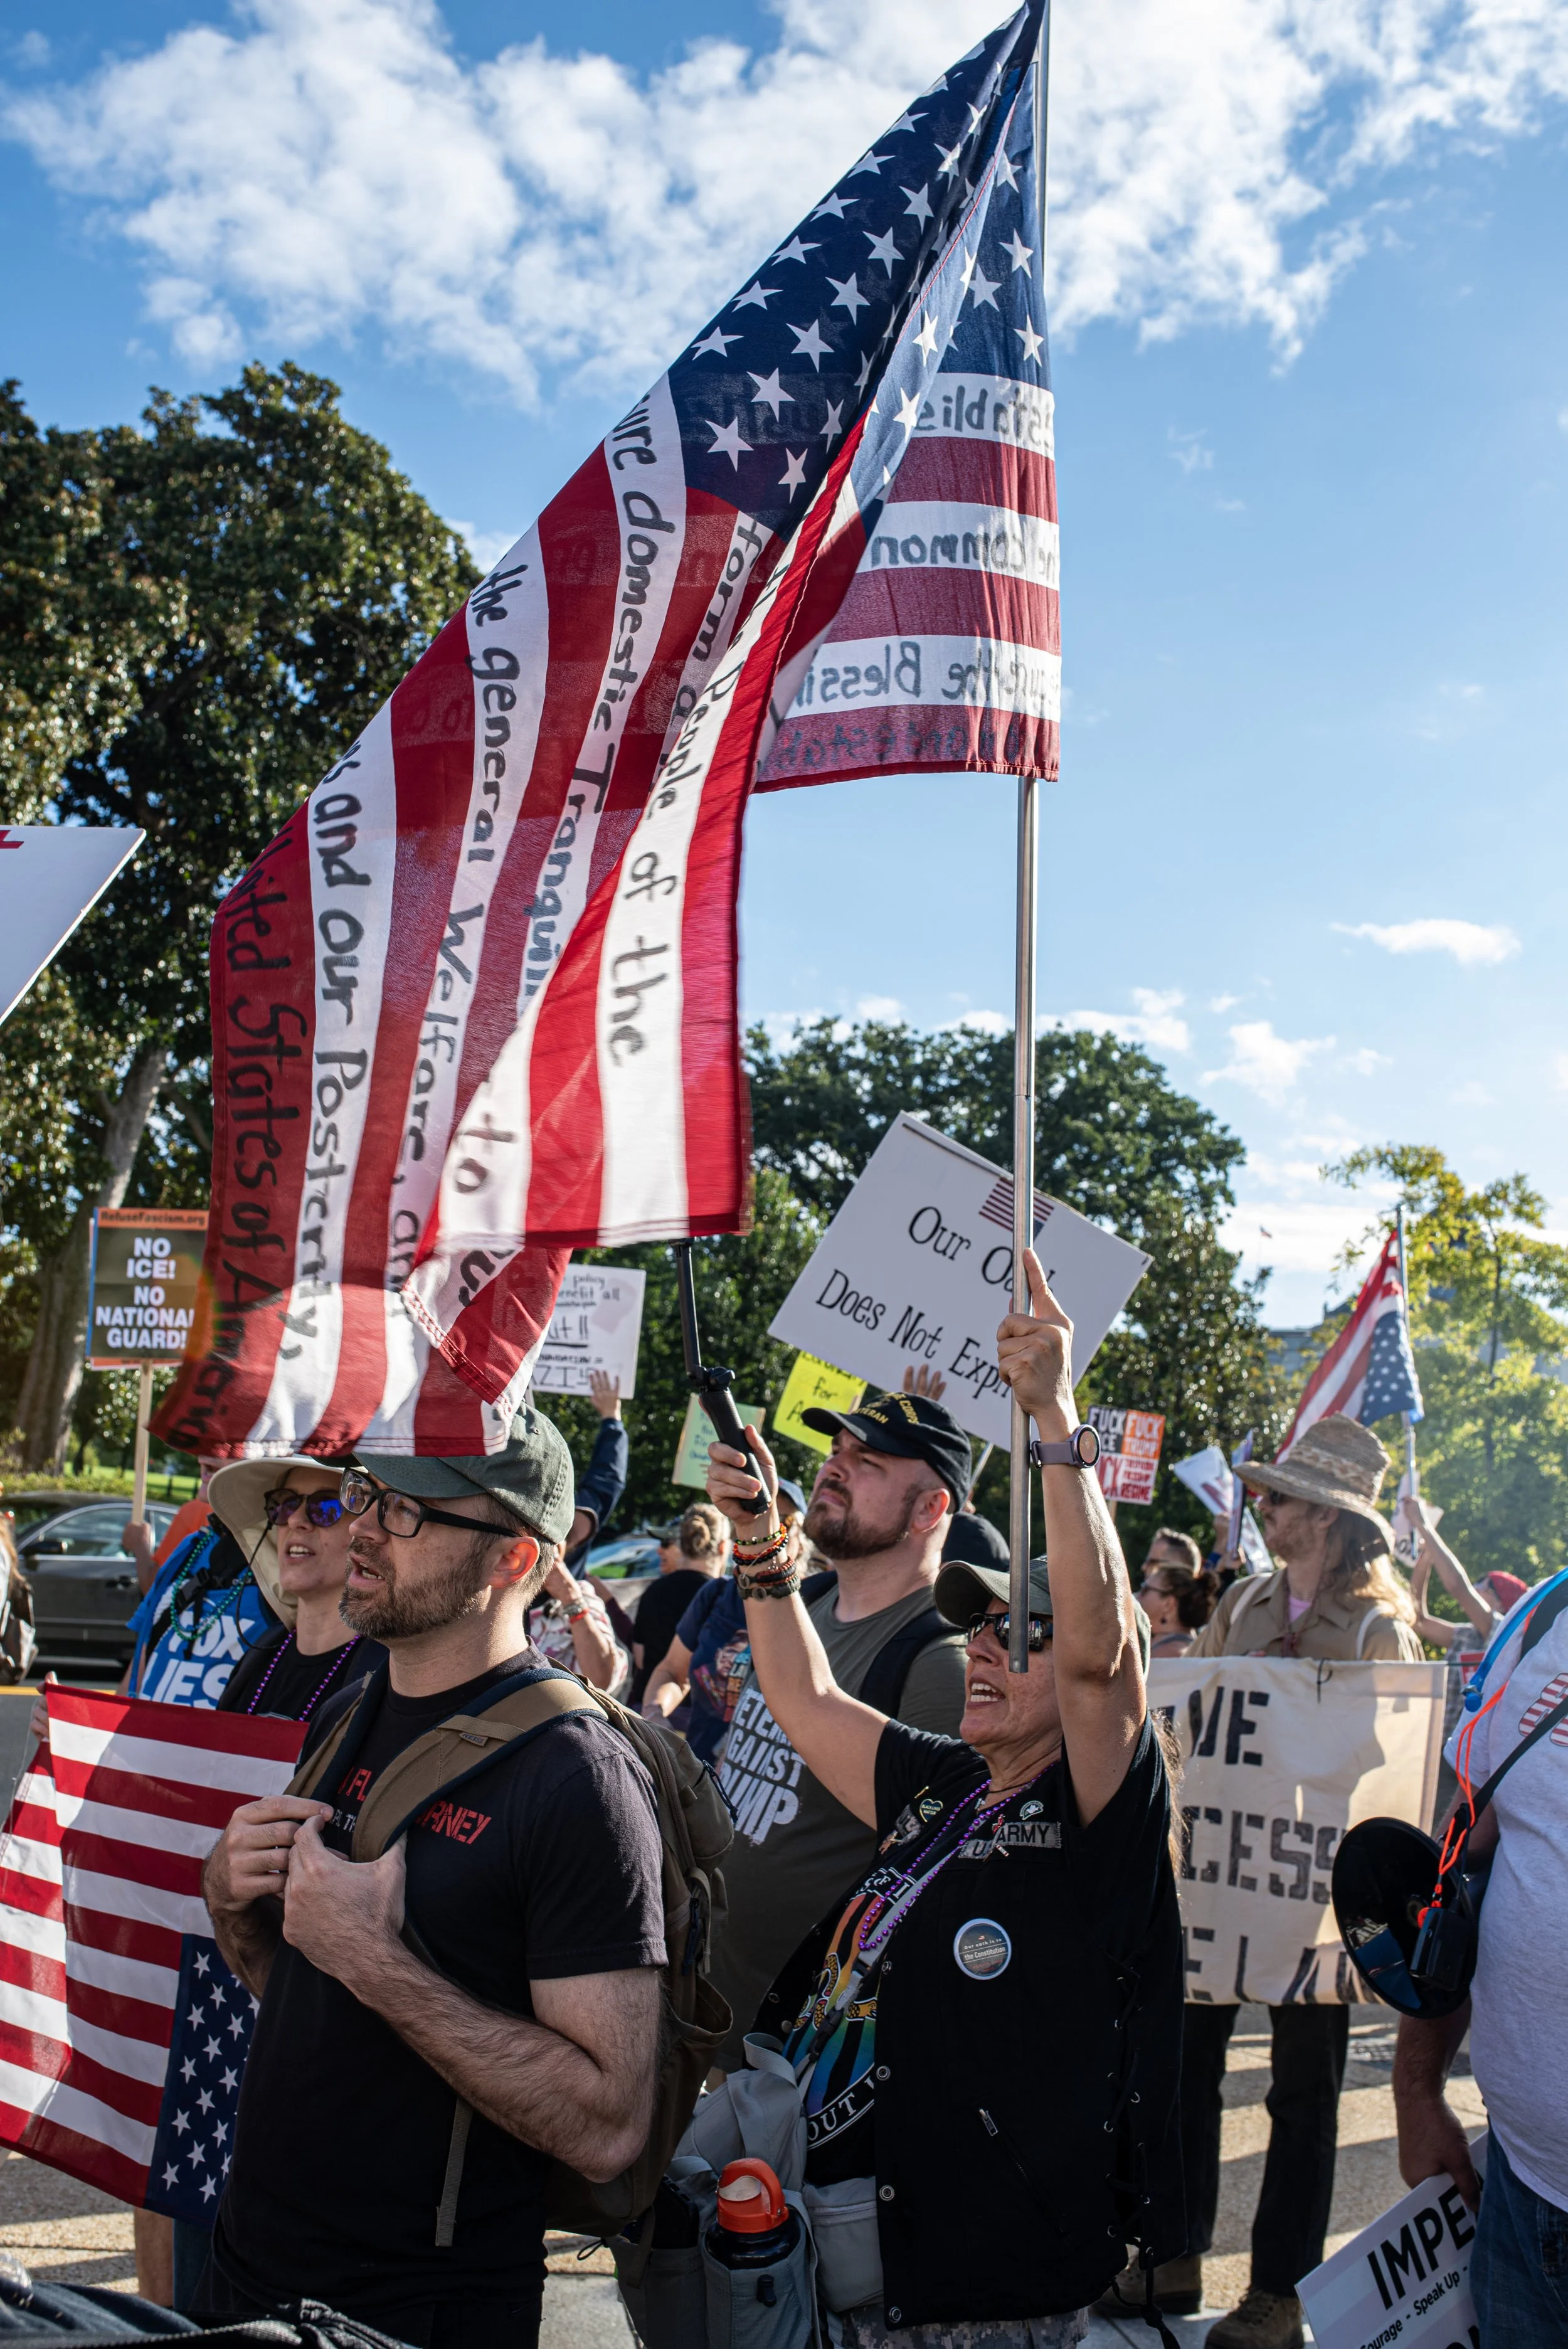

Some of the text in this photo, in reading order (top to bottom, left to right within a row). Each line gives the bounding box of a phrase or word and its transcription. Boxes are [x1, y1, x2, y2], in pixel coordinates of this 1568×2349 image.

[470, 564, 529, 627] the
[593, 490, 676, 732] domestic
[692, 519, 763, 662] form
[464, 647, 521, 863] general
[314, 793, 373, 888] and
[625, 851, 679, 903] of
[319, 910, 364, 1026] our
[608, 935, 669, 1066] the
[226, 996, 307, 1188] States
[453, 1112, 516, 1194] to
[134, 1236, 172, 1258] NO
[221, 1201, 287, 1255] of
[908, 1206, 972, 1261] Our
[126, 1258, 176, 1280] ICE!
[134, 1285, 166, 1307] NO
[107, 1327, 187, 1349] GUARD!
[815, 1268, 887, 1330] Does
[887, 1305, 944, 1359] Not
[1089, 1408, 1126, 1435] FUCK
[1124, 1437, 1158, 1458] TRUMP
[1126, 1413, 1161, 1441] FUCK
[167, 1610, 255, 1662] FOX
[138, 1652, 234, 1710] LIES
[727, 1728, 809, 1788] GAINST
[995, 1824, 1050, 1845] ARMY
[974, 1946, 1006, 1958] Constitution
[1413, 2281, 1446, 2316] Speak
[1443, 2270, 1460, 2290] Up
